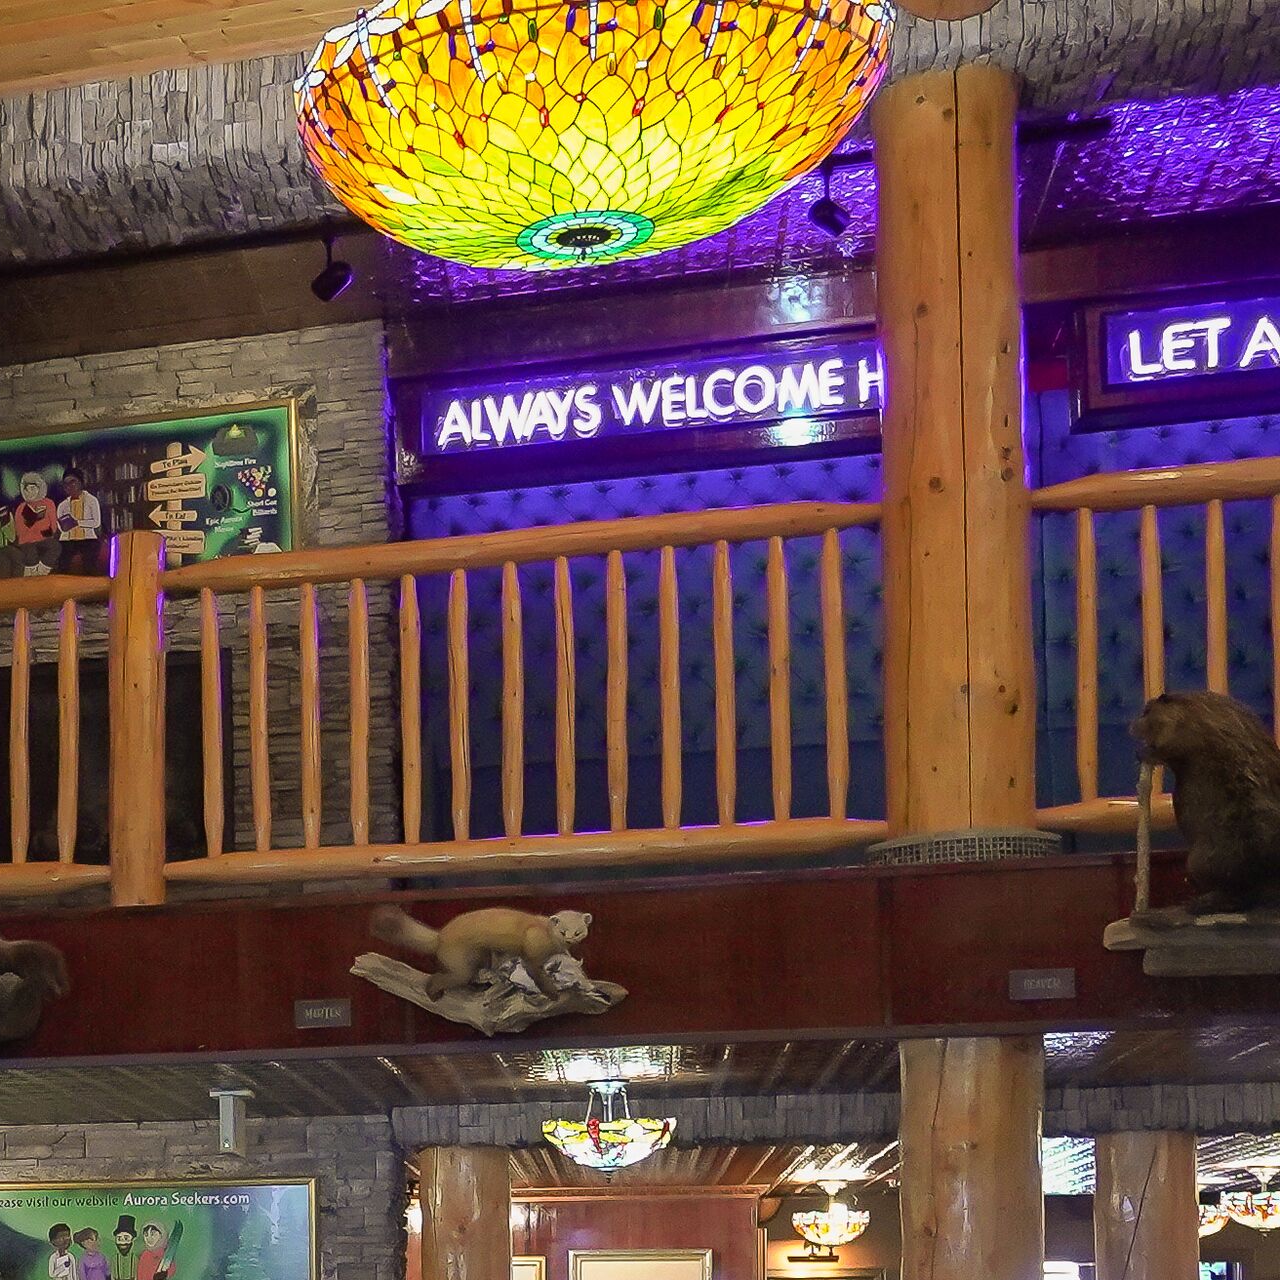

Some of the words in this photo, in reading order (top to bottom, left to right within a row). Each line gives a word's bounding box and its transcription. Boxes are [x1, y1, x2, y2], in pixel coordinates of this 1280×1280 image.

[1128, 316, 1232, 376] LET
[438, 384, 602, 447] ALWAYS
[612, 359, 844, 426] WELCOME
[858, 359, 883, 404] H
[26, 1196, 49, 1207] visit
[52, 1198, 72, 1207] our
[75, 1195, 119, 1207] website
[123, 1193, 168, 1206] Aurora
[171, 1191, 250, 1205] Seekers.com
